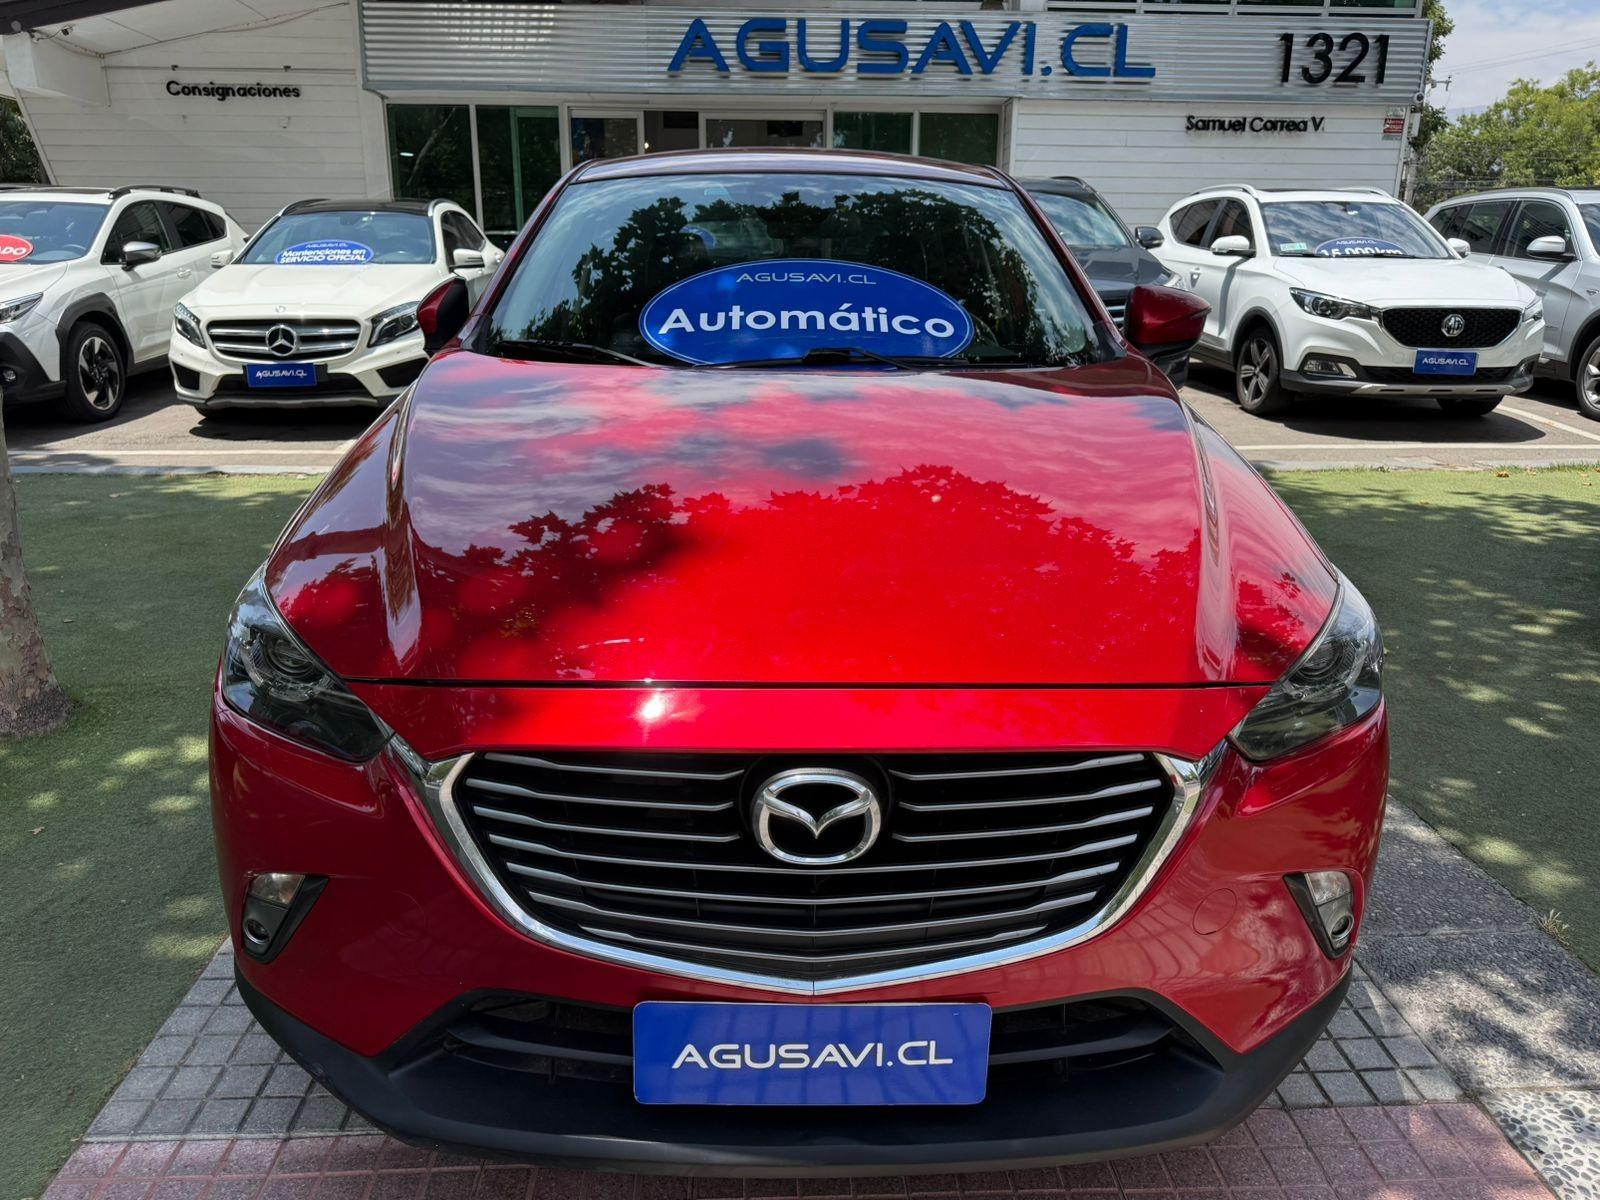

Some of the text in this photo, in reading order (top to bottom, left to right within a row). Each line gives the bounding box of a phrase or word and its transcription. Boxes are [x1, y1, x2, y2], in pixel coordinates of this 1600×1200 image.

[667, 17, 1156, 80] AGUSAVI.CL
[1279, 32, 1390, 85] 1321
[165, 80, 301, 101] Consignaciones
[1185, 114, 1247, 132] Samuel
[1249, 116, 1308, 133] Correa
[280, 254, 326, 263] SERVICIO
[282, 248, 351, 257] Mantenciones
[736, 272, 877, 285] AGUSAVI.CL
[658, 303, 955, 338] Automático
[1422, 357, 1469, 366] AGUSAVI.CL
[255, 369, 308, 379] AGUSAVI.CL
[672, 1040, 954, 1069] AGUSAVI.CL
